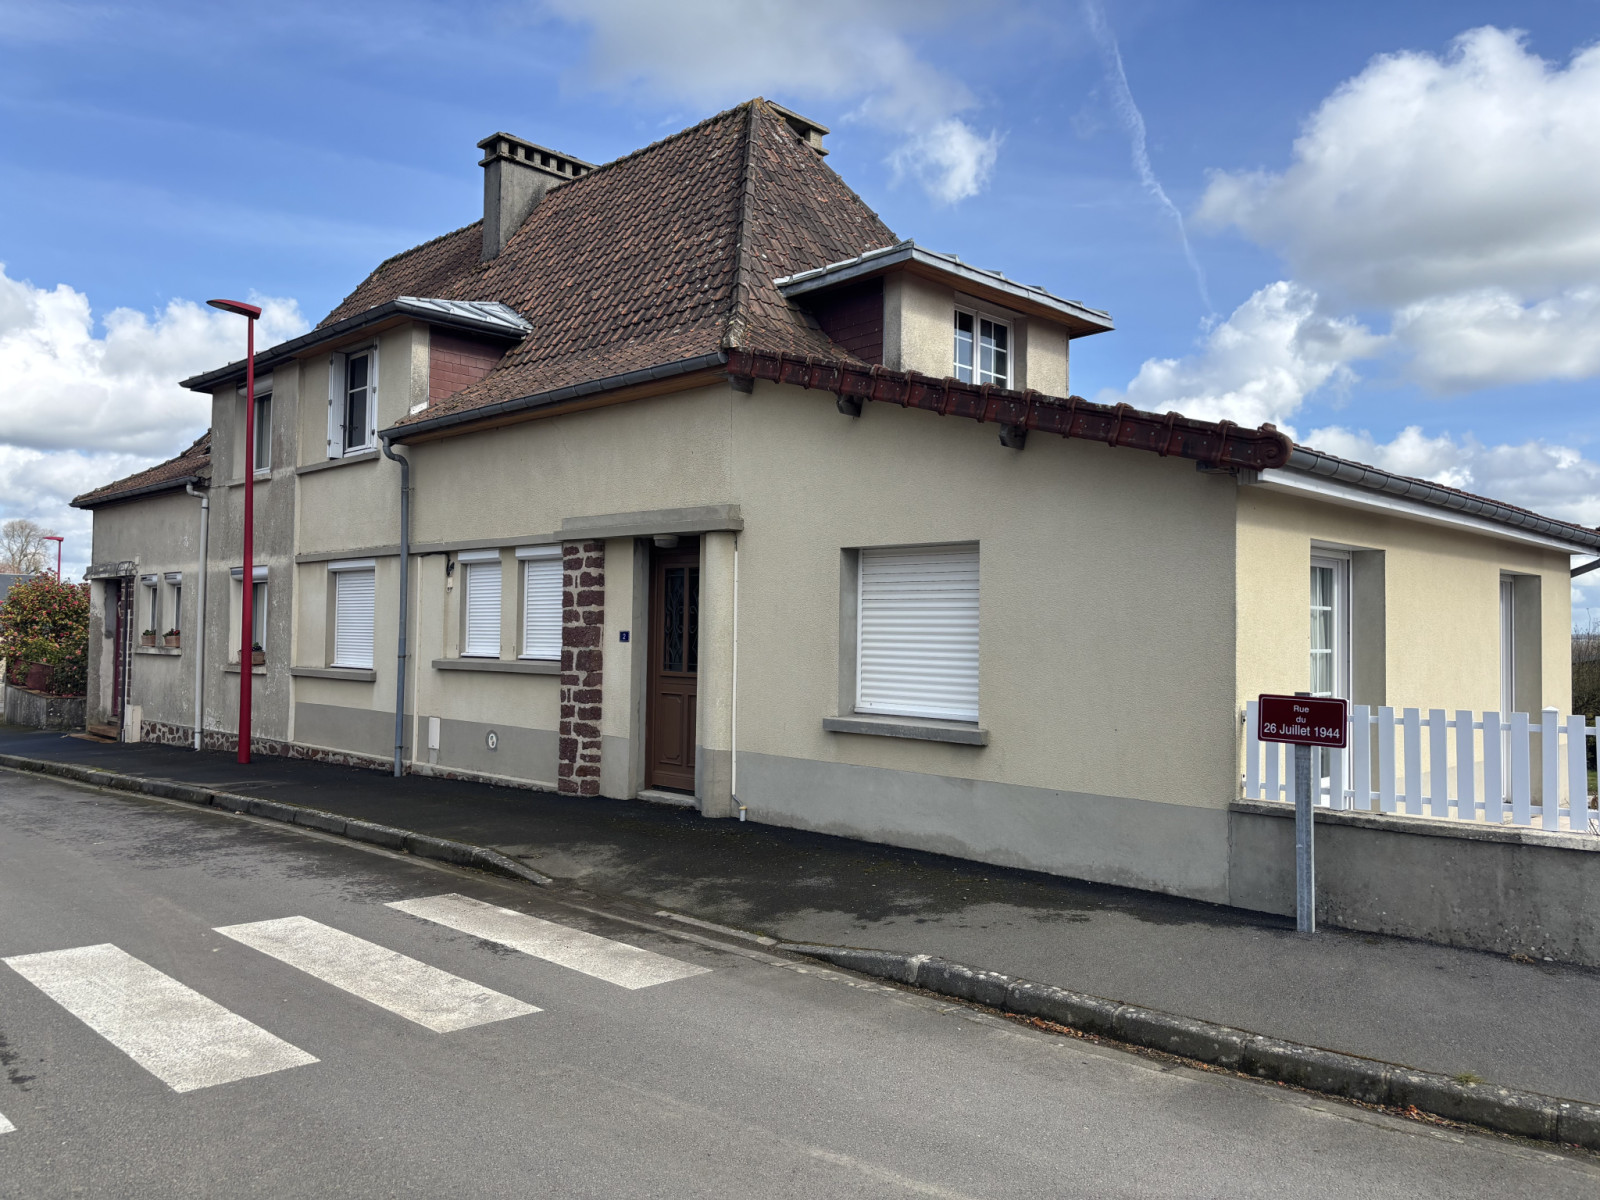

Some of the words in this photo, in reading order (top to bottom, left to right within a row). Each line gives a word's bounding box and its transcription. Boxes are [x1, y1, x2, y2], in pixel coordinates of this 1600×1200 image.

[1293, 705, 1310, 713] Rue
[1295, 715, 1307, 723] du
[1264, 722, 1277, 733] 26
[1279, 724, 1311, 736] Juillet
[1314, 726, 1340, 738] 1944
